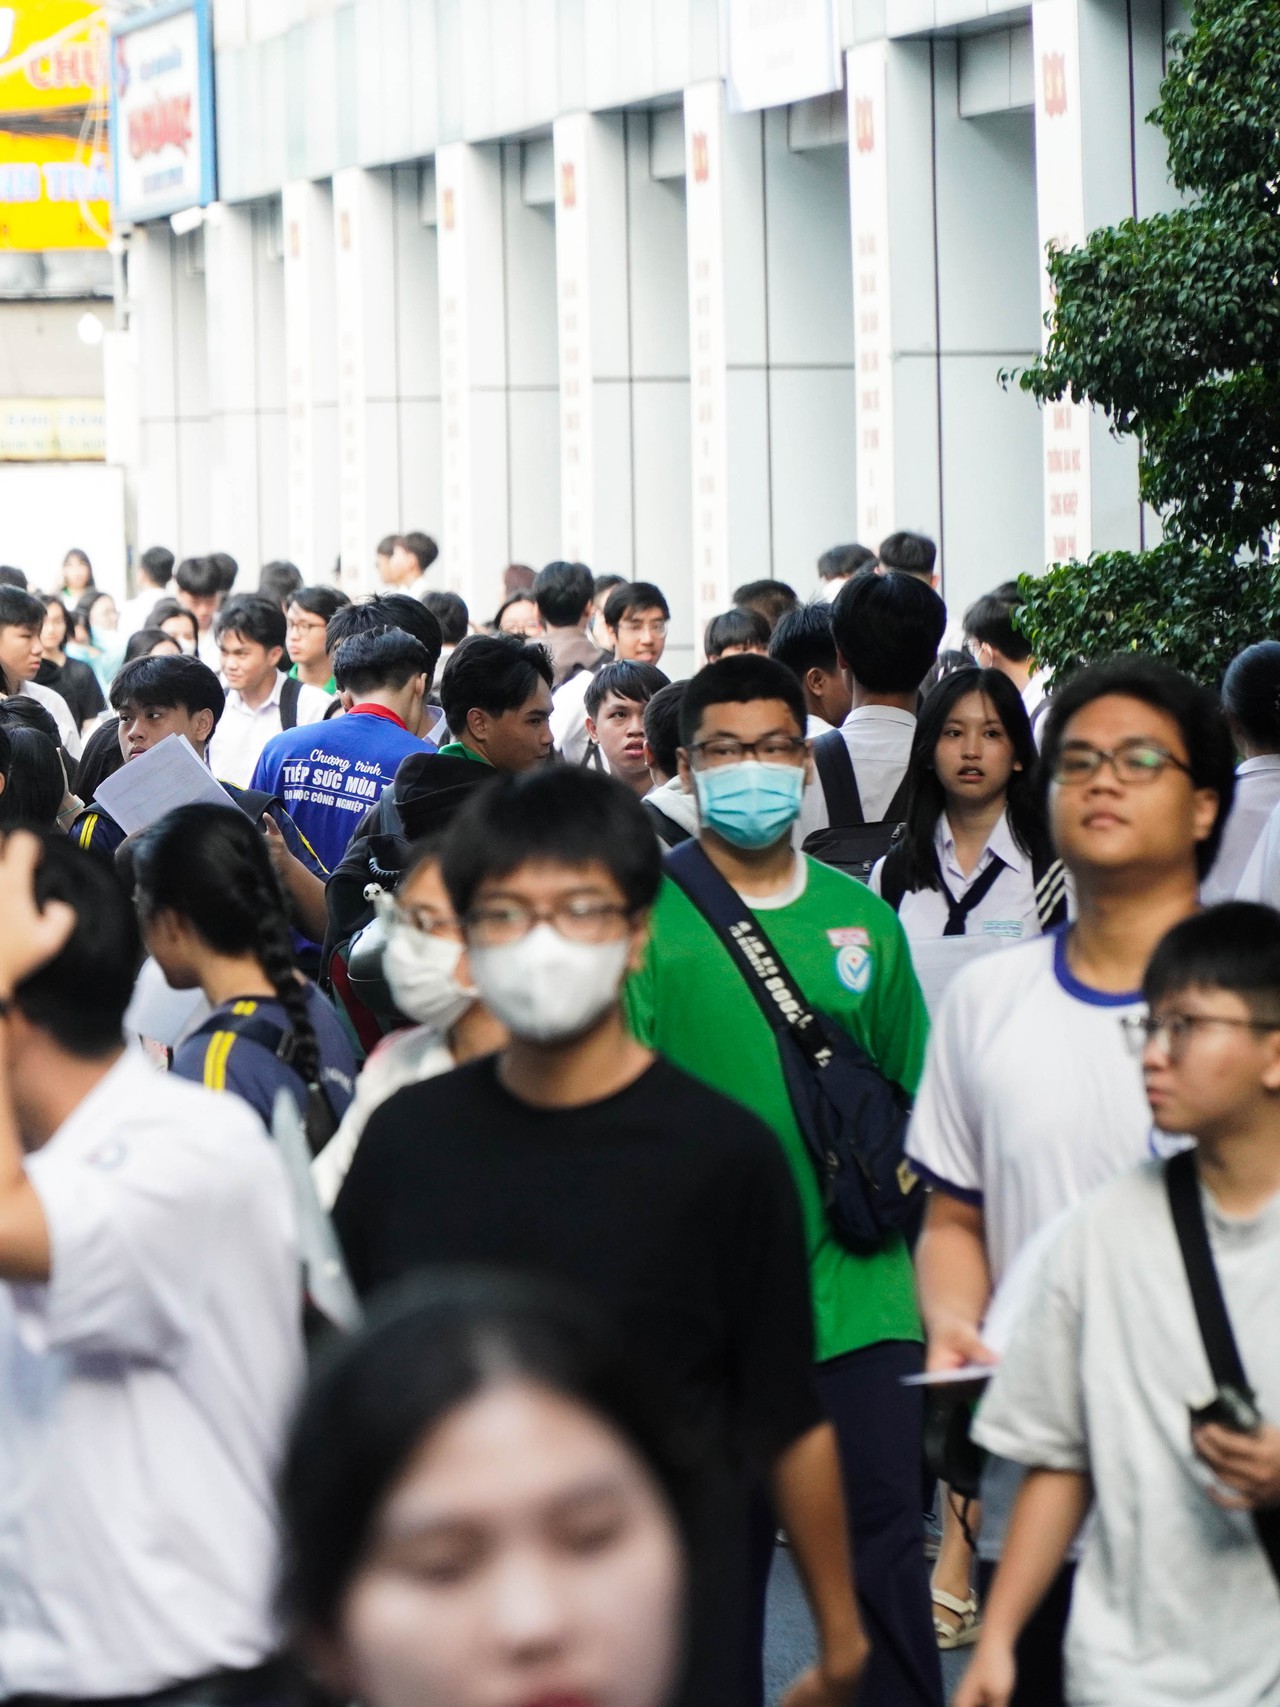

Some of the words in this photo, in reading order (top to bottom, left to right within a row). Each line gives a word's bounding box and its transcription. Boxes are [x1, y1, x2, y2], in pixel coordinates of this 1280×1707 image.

[310, 749, 352, 774] Chương
[355, 759, 383, 777] trình
[283, 761, 310, 784] TIẾP
[312, 769, 342, 790] SỨC
[344, 775, 377, 799] MÙA
[310, 791, 334, 807] CÔNG
[335, 797, 364, 814] NGHIỆP
